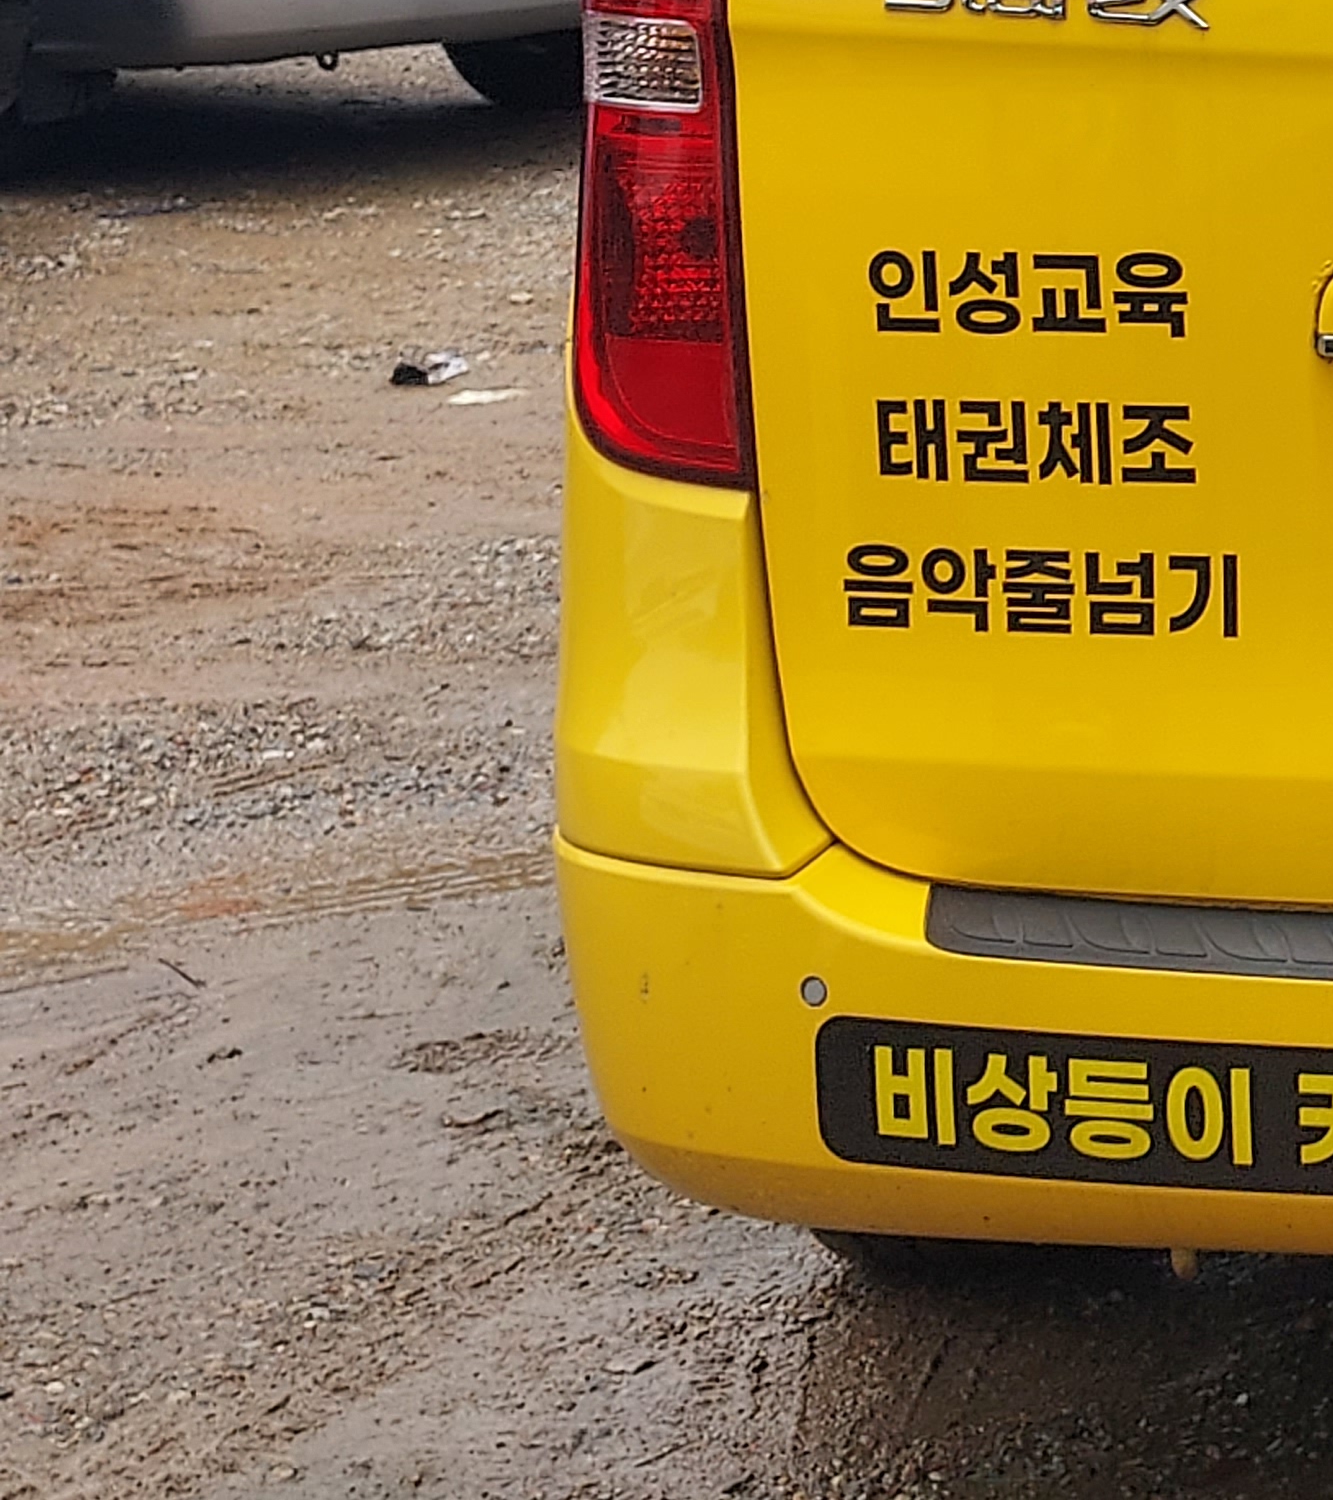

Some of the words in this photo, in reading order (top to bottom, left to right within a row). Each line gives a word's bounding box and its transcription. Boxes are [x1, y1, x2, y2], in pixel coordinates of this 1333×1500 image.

[868, 250, 1188, 337] 인성교육
[876, 399, 1197, 484] 태권체조
[843, 544, 1239, 638] 음악줄넘기
[874, 1046, 1252, 1165] 비상등이
